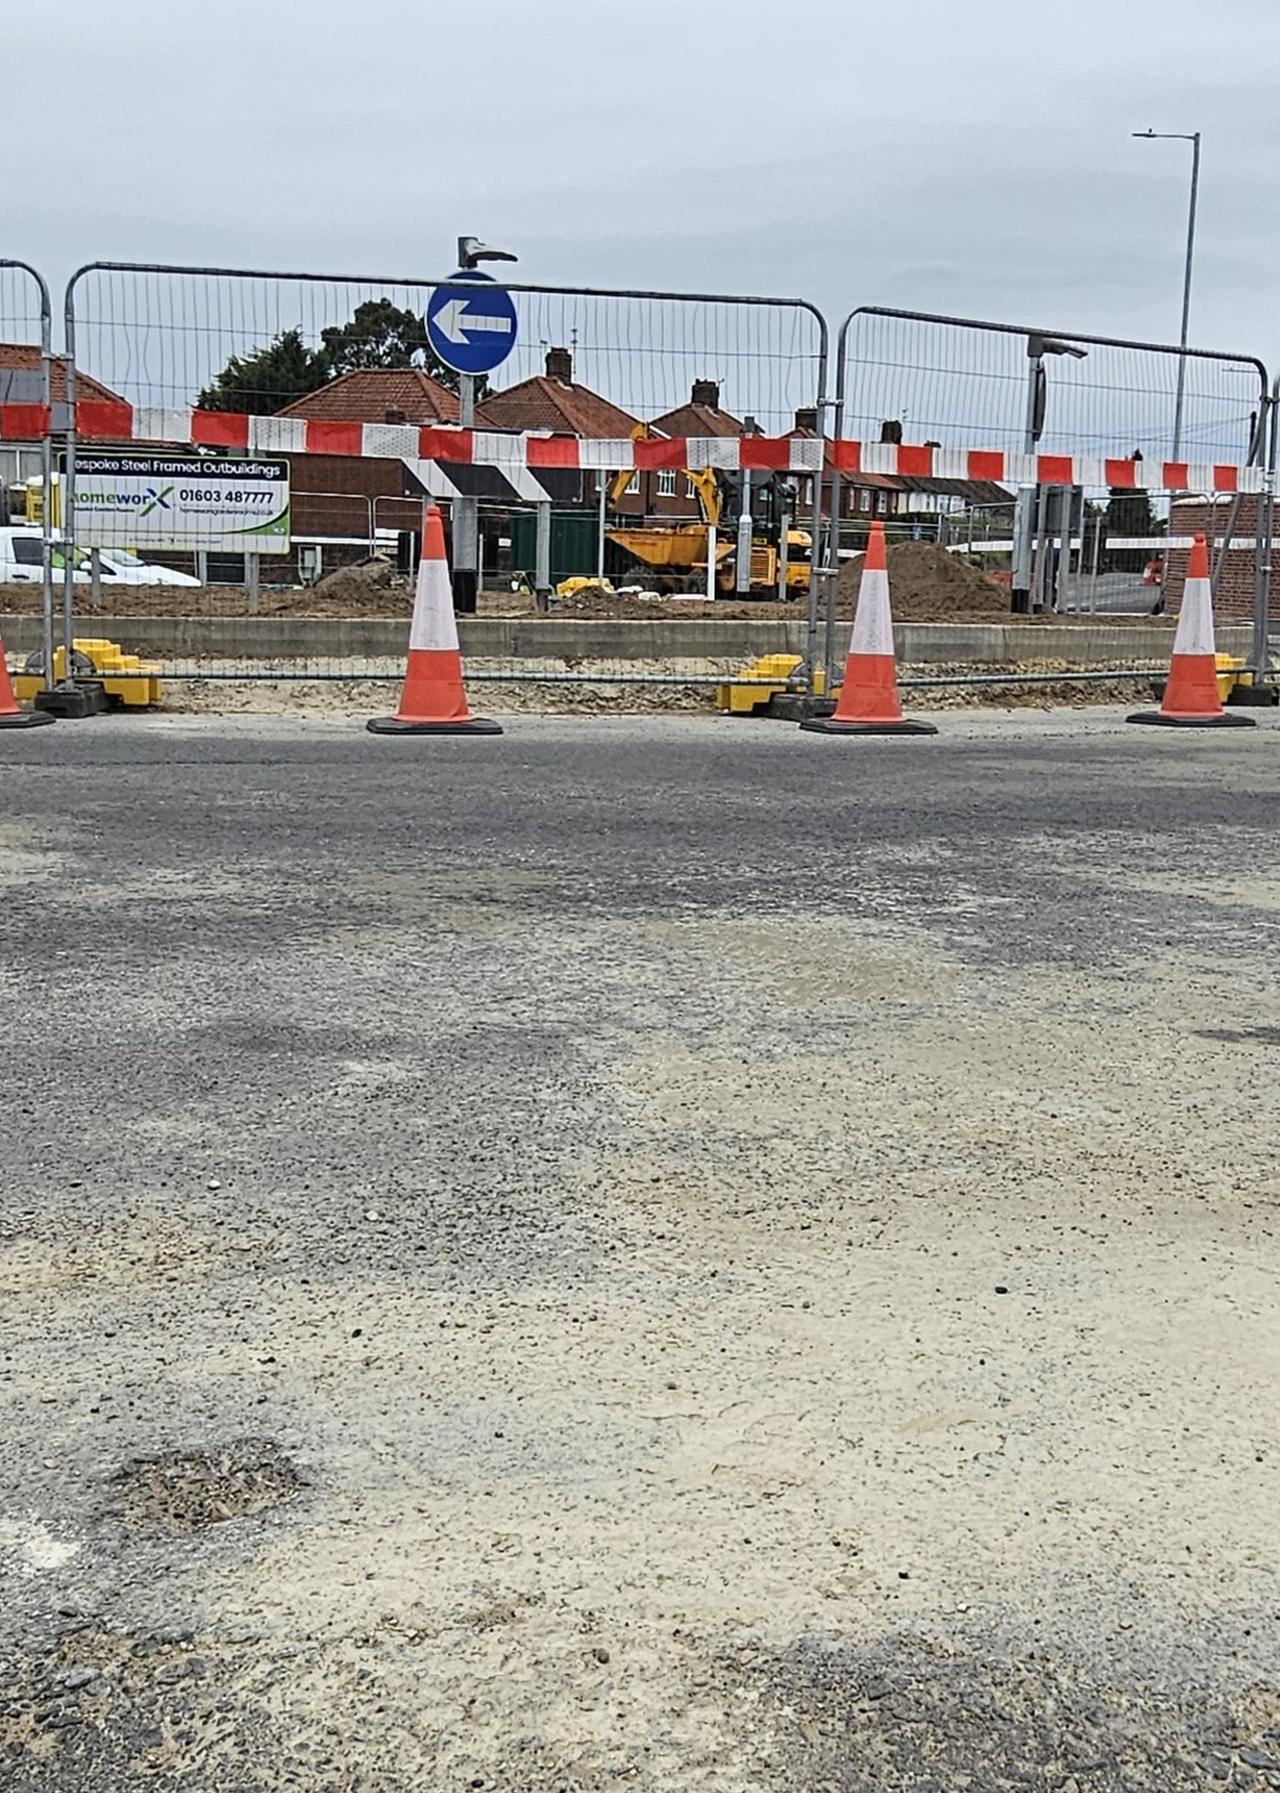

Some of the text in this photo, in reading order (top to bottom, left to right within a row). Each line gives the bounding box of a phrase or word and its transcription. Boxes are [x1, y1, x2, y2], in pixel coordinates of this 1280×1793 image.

[75, 459, 280, 479] espoke Steel Framed Outbuildings
[180, 489, 274, 504] 01603 487777
